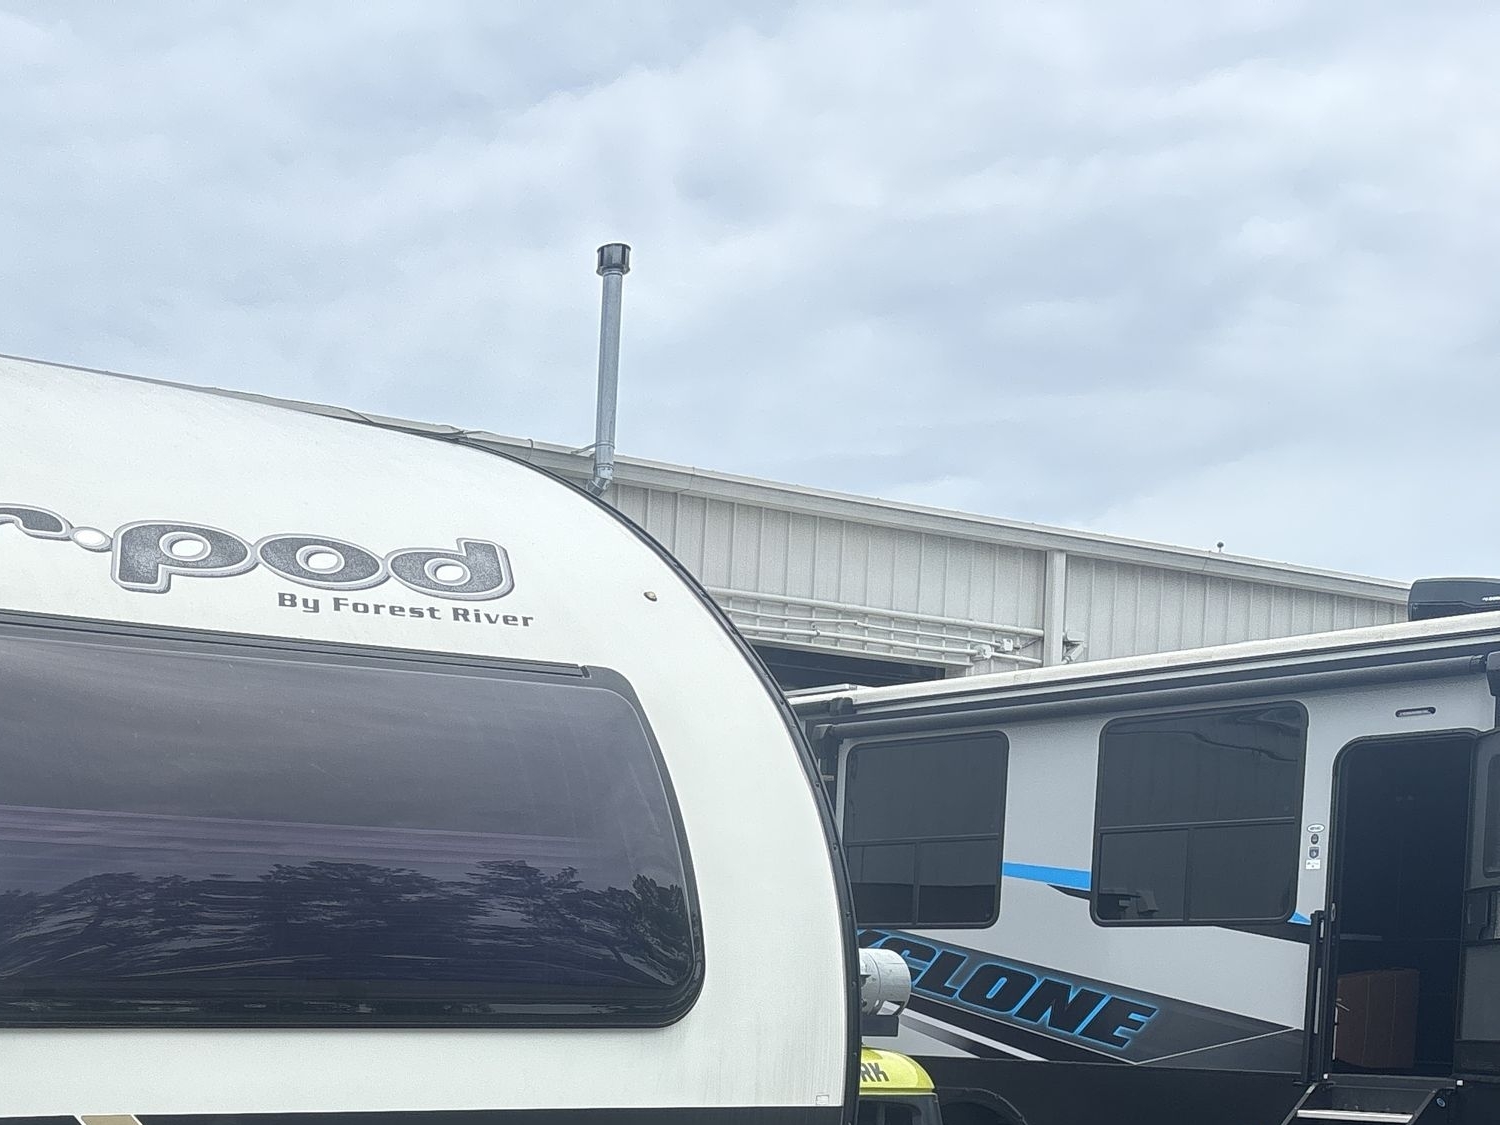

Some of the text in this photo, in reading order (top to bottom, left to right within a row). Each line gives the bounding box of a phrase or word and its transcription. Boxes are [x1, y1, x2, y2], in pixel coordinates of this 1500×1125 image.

[277, 592, 534, 627] By Forest River
